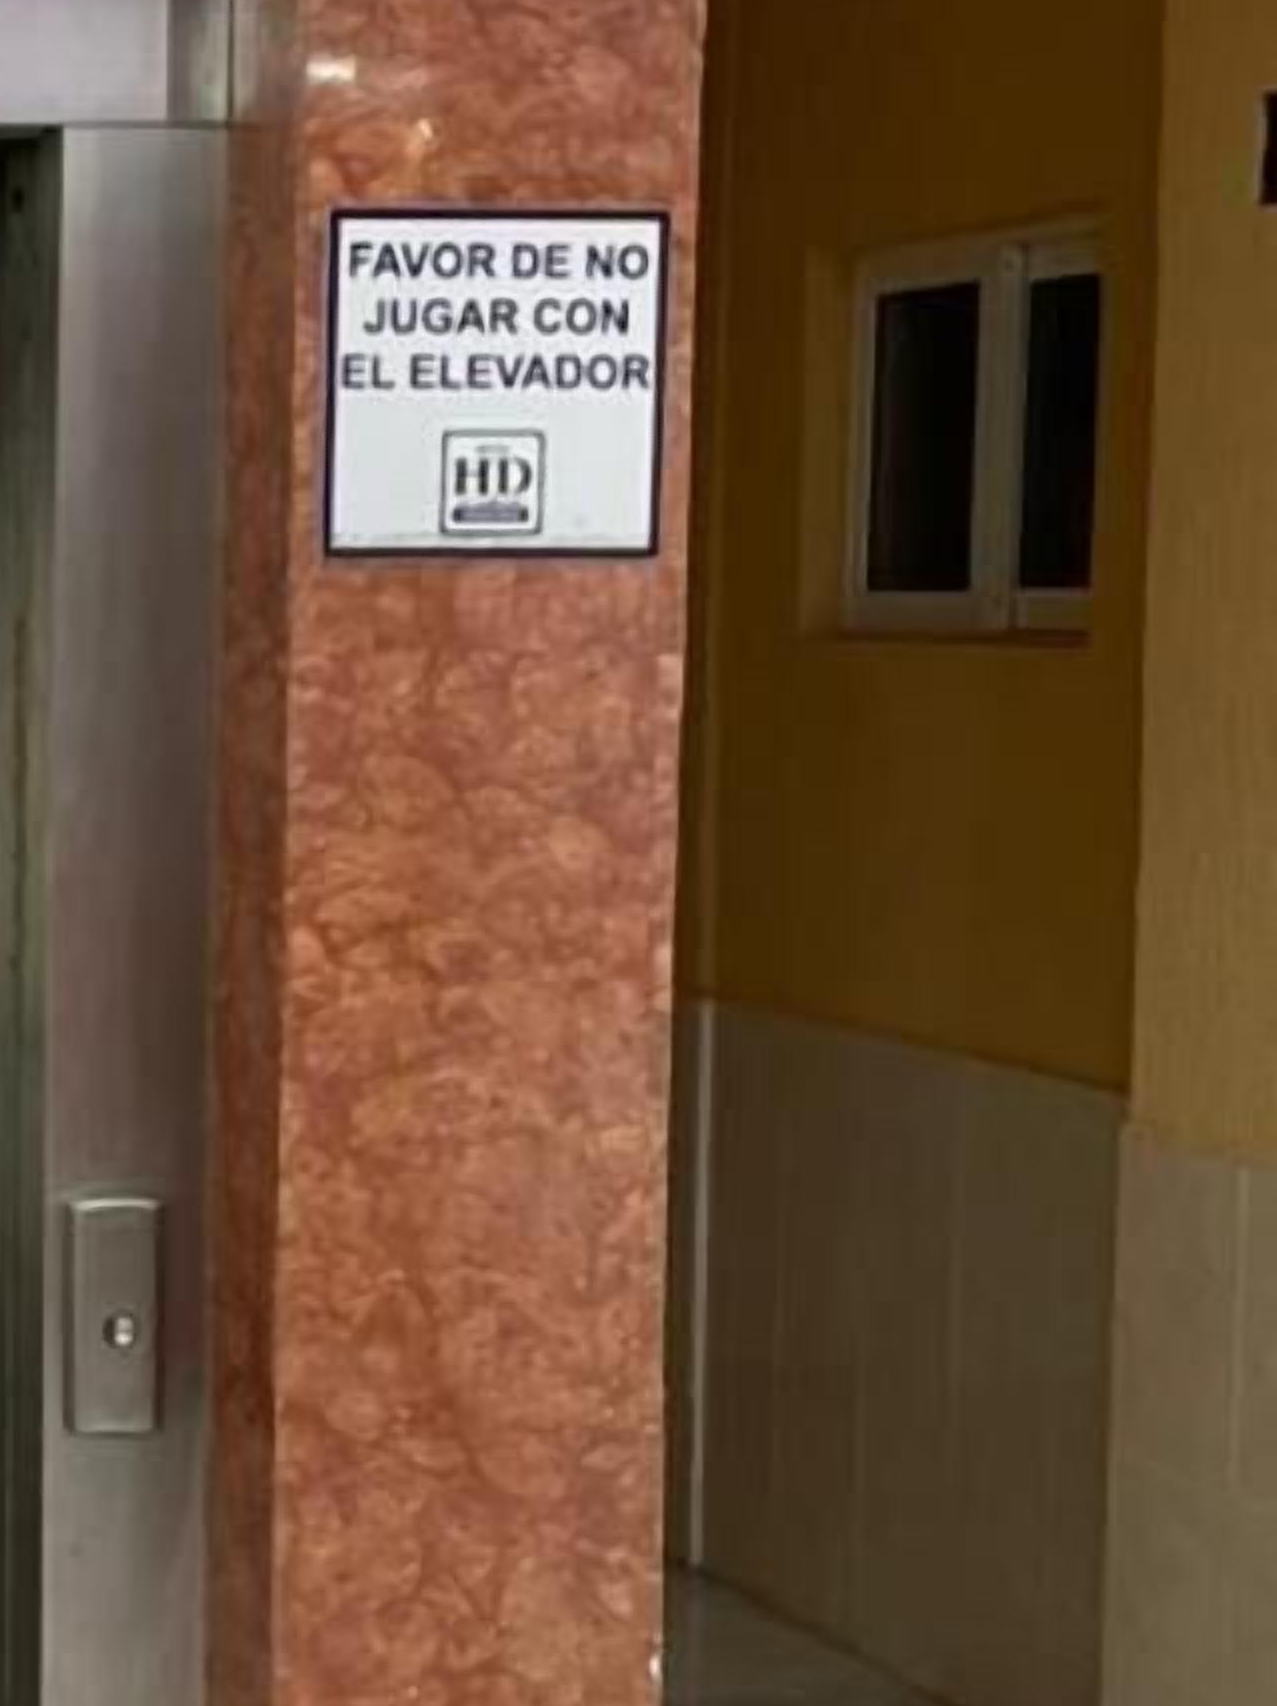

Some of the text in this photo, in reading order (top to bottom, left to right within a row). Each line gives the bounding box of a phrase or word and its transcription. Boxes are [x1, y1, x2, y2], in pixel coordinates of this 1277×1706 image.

[348, 241, 650, 280] FAVOR DE NO
[363, 297, 629, 336] JUGAR CON
[341, 353, 651, 391] EL ELEVADOR
[455, 456, 532, 495] HD
